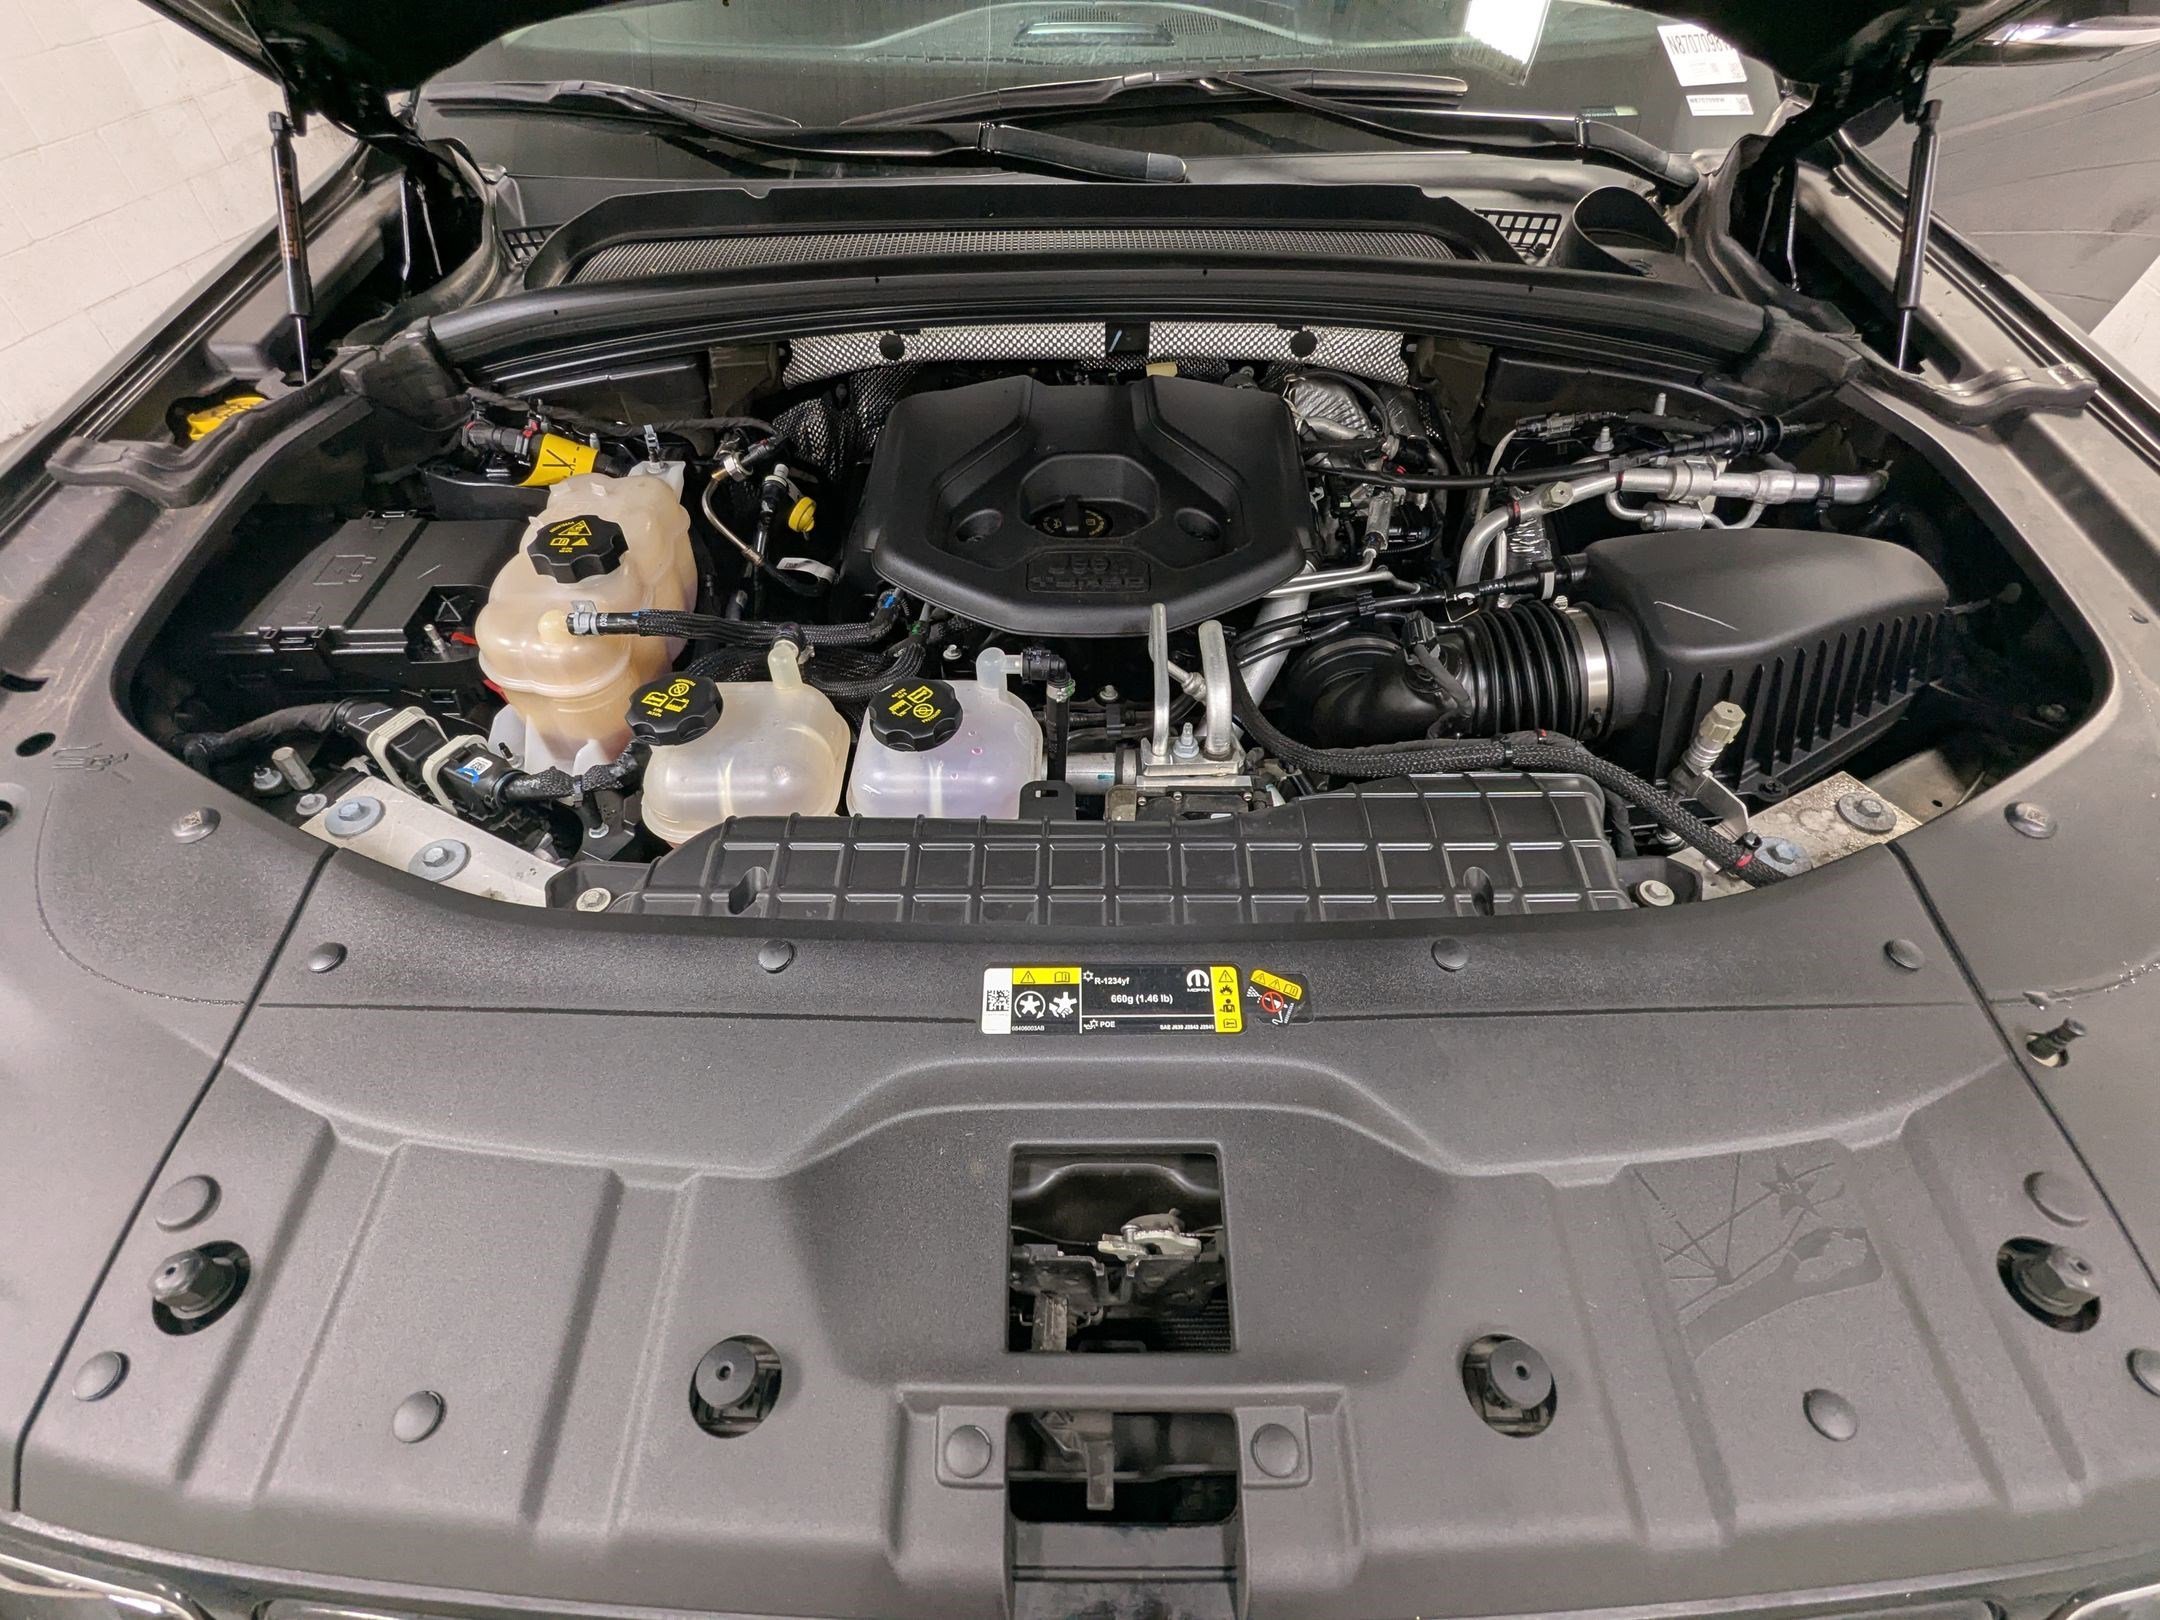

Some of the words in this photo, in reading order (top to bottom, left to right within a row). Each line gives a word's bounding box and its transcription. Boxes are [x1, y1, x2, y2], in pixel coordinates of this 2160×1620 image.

[1094, 977, 1130, 986] R-1234yf
[1111, 994, 1134, 1004] 660g
[1136, 994, 1159, 1004] (1.46
[1160, 994, 1174, 1004] lb)
